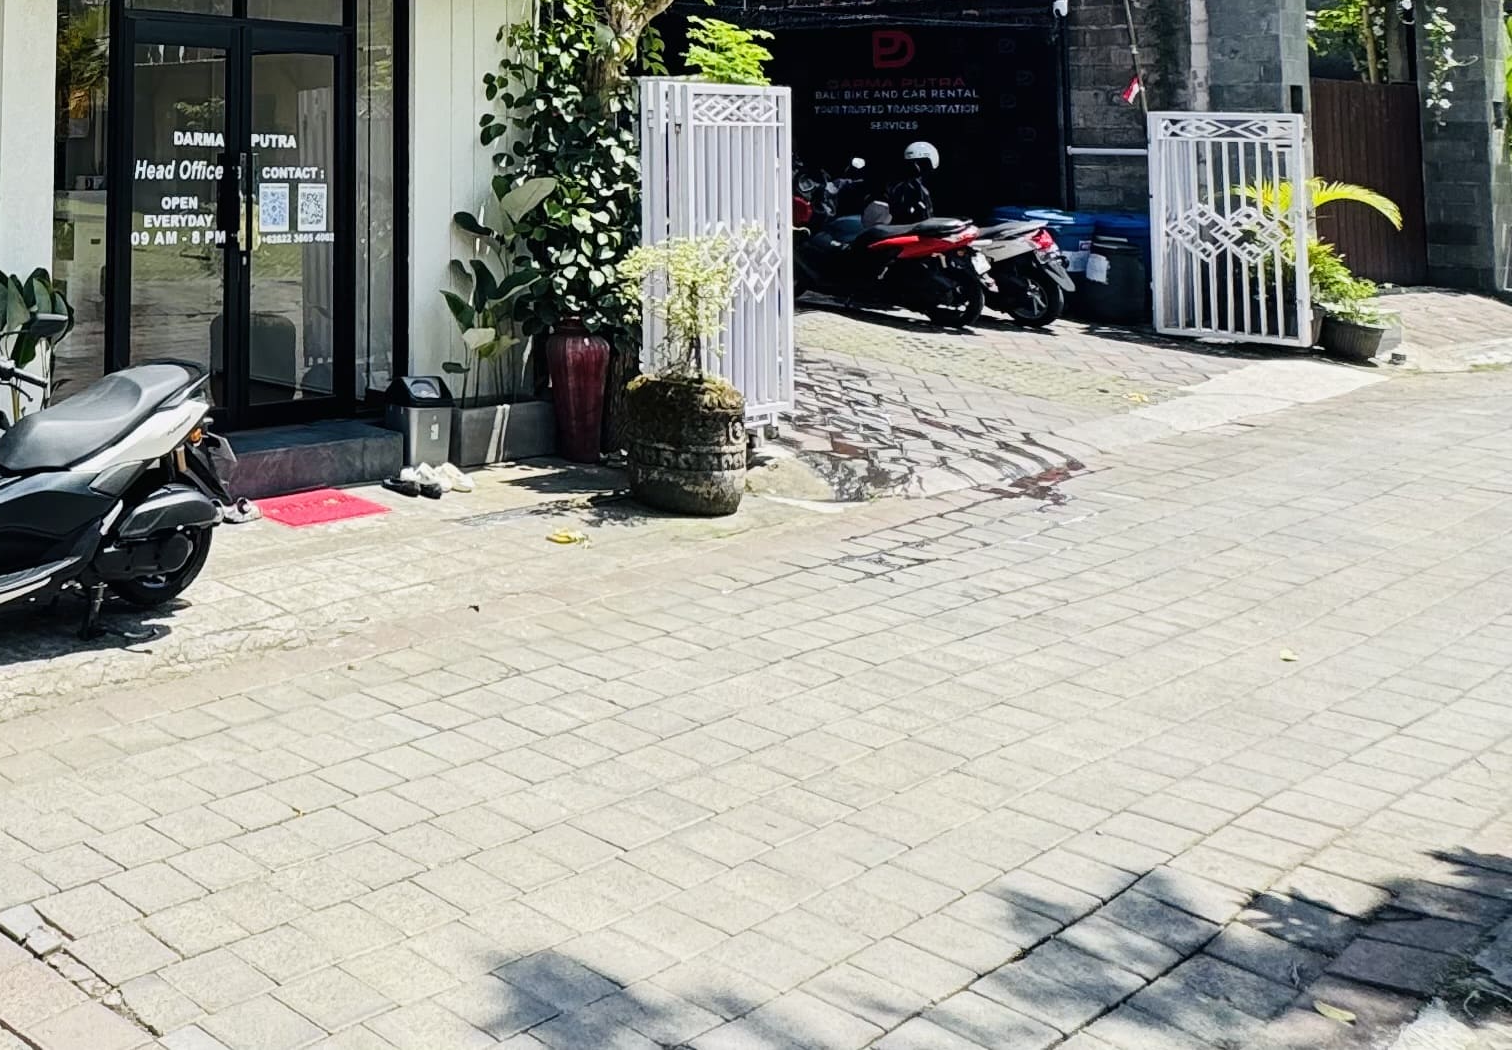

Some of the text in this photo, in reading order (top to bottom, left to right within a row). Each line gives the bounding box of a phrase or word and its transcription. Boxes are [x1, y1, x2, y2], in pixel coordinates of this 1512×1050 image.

[844, 90, 870, 99] BIKE
[873, 90, 898, 99] AND
[902, 89, 927, 99] CAR
[931, 88, 980, 99] RENTAL
[887, 104, 979, 114] TRANSPORTATION
[870, 121, 919, 130] SERVICES
[173, 131, 297, 149] DARMA PUTRA
[134, 160, 224, 180] Head Office
[262, 167, 318, 179] CONTACT
[161, 196, 198, 210] OPEN
[144, 214, 214, 228] EVERYDAY
[131, 231, 150, 246] 09
[153, 231, 178, 245] AM
[191, 231, 200, 245] 8
[205, 230, 226, 245] PM
